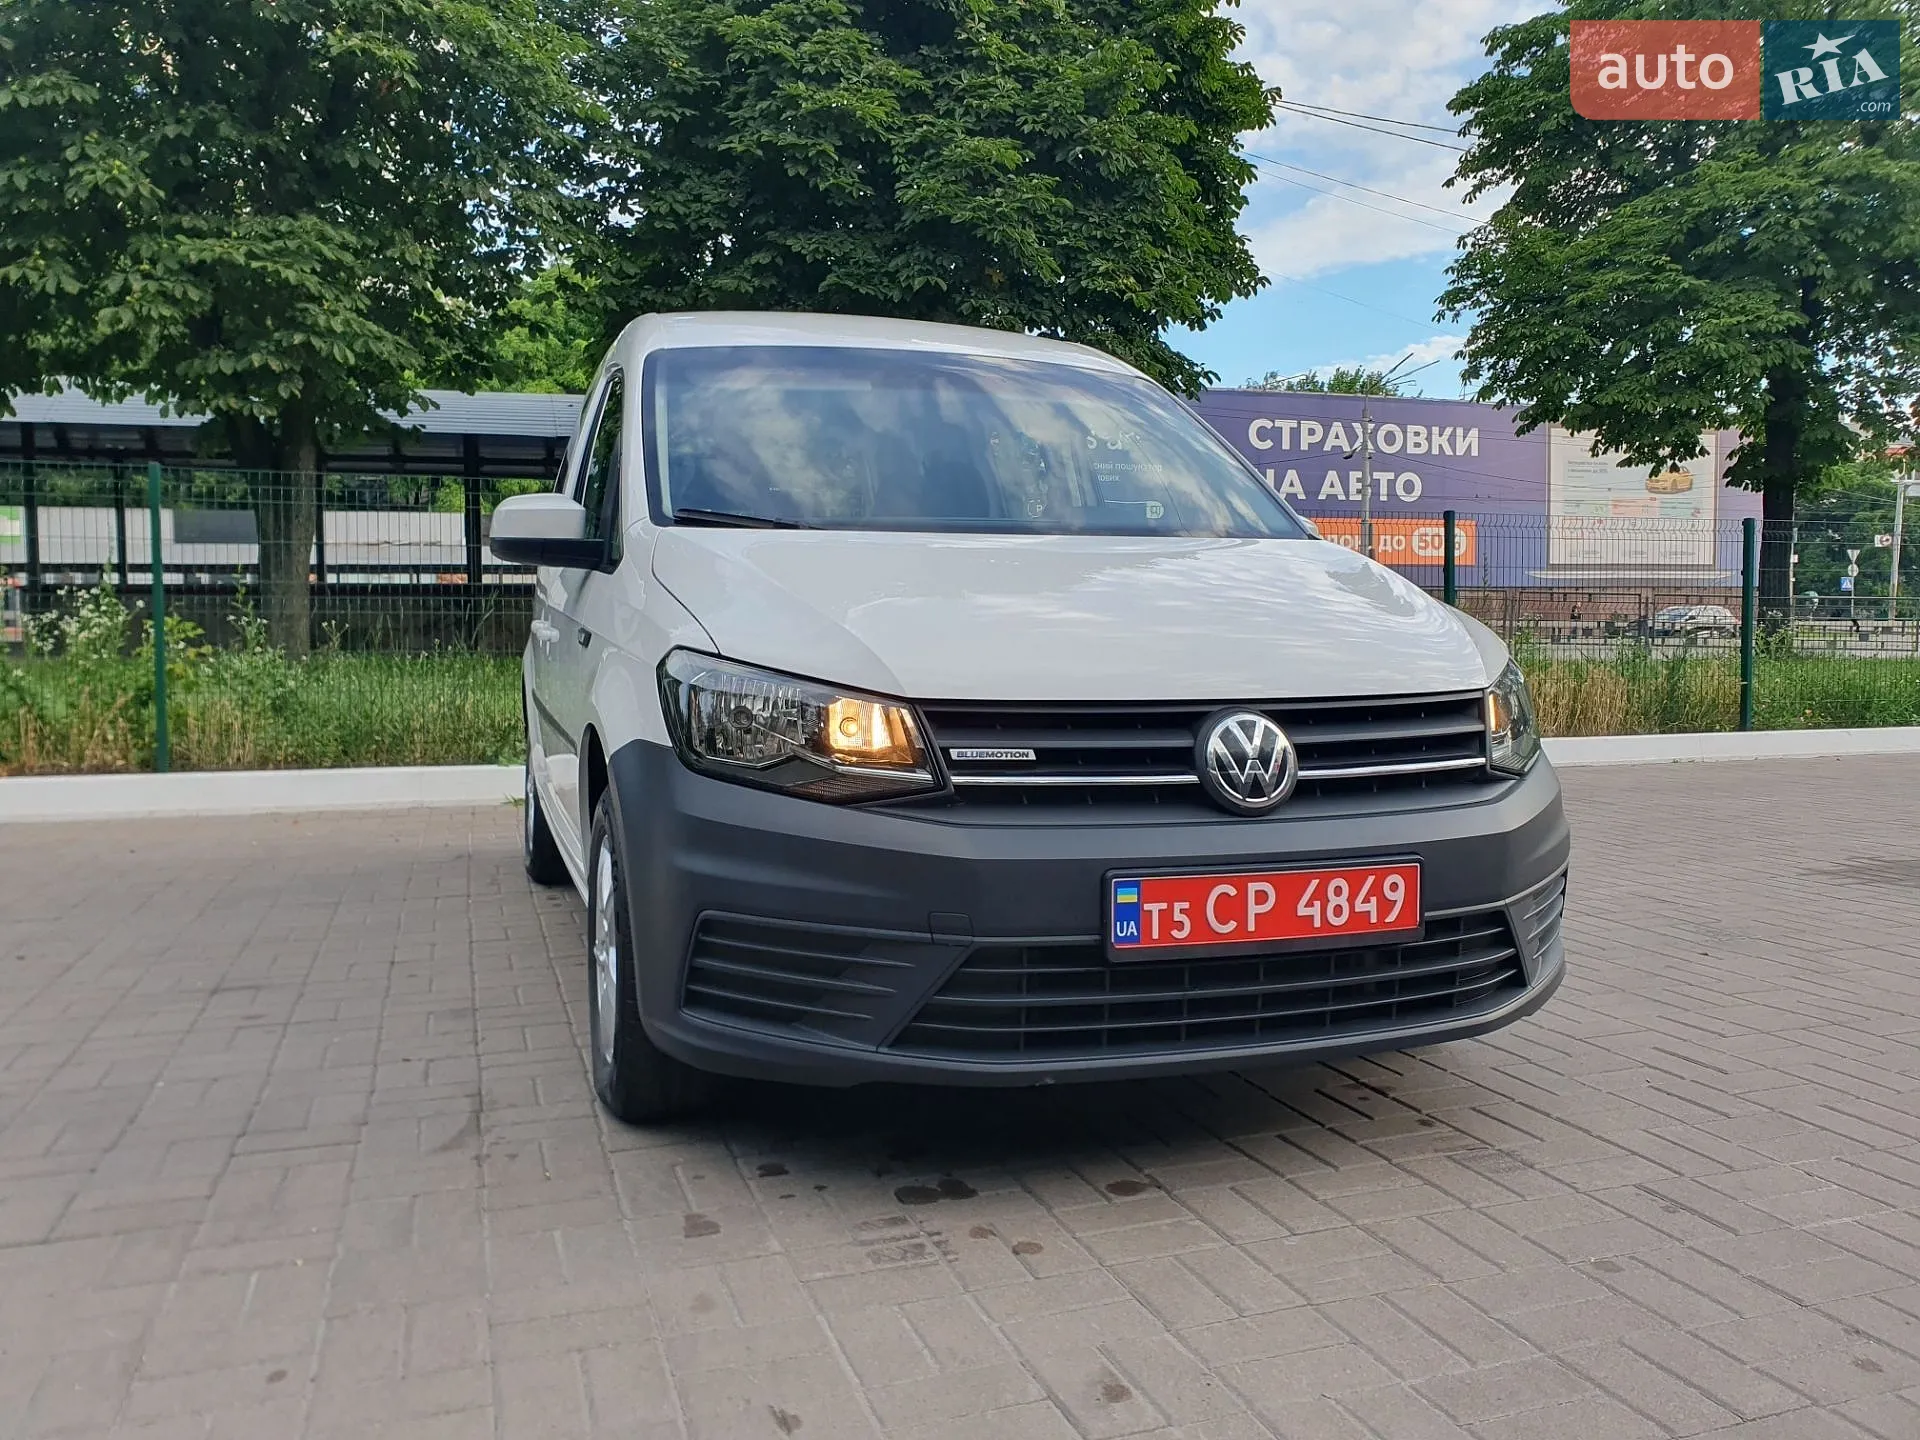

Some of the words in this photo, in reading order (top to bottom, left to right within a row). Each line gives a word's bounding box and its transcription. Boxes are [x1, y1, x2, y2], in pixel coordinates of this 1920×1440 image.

[1248, 418, 1480, 457] СТРАХОВКИ
[1318, 469, 1423, 502] АВТО
[957, 751, 1030, 759] BLUEMOTION
[1143, 901, 1192, 940] T5
[1206, 882, 1276, 934] CP
[1296, 873, 1406, 929] 4849
[1116, 921, 1138, 937] UA
